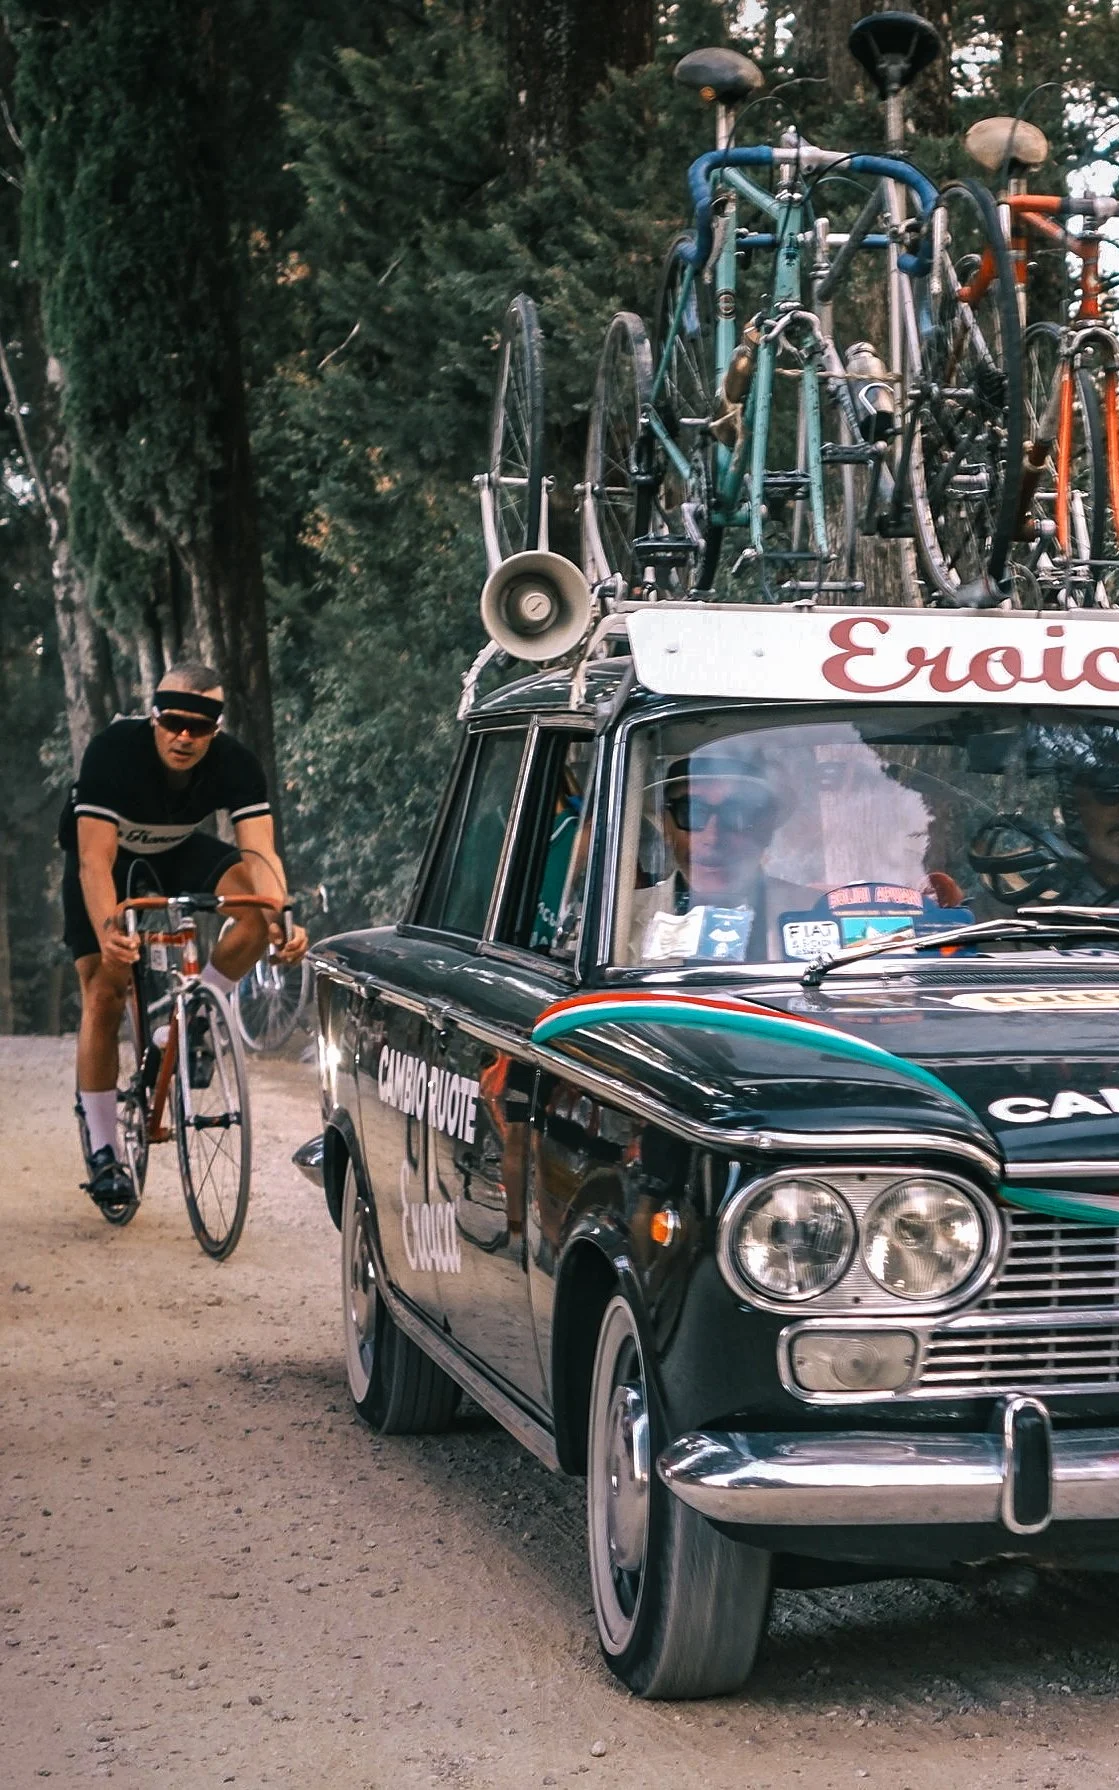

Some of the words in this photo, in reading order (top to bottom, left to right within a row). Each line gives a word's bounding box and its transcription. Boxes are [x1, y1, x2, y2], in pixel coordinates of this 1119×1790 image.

[788, 923, 834, 938] FIAT
[378, 1045, 427, 1120] CAMBIO
[428, 1066, 480, 1145] RUOTE
